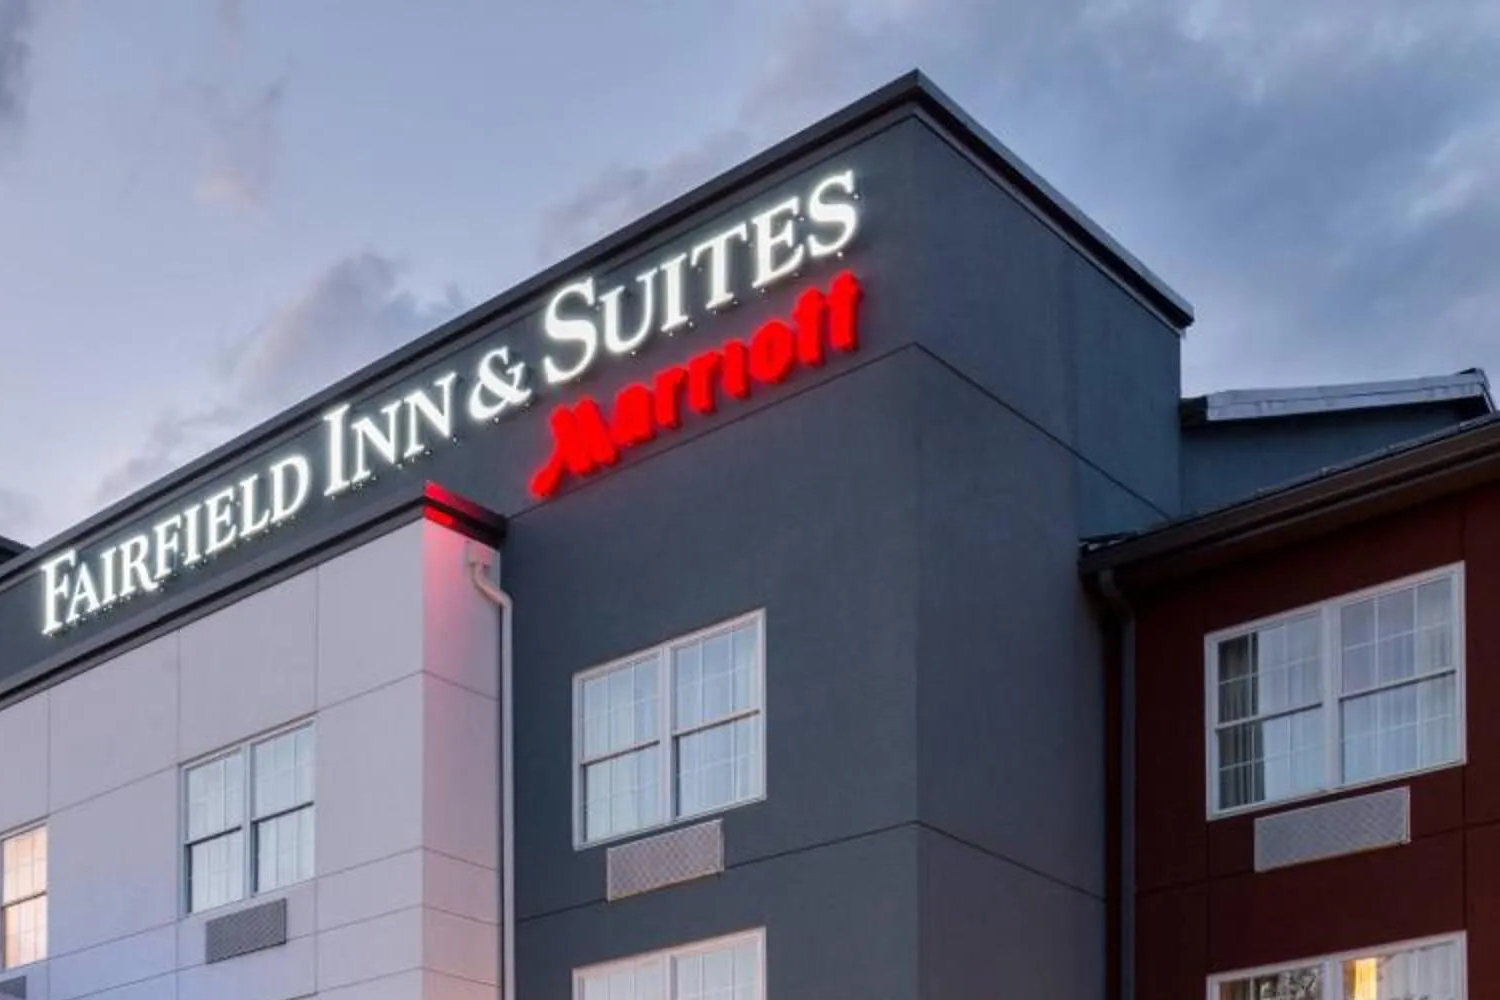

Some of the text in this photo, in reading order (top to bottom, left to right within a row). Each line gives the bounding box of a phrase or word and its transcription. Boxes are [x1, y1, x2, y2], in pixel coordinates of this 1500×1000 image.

[41, 170, 859, 636] FAIRFIELD INN & SUITES
[528, 270, 860, 499] Marriott
